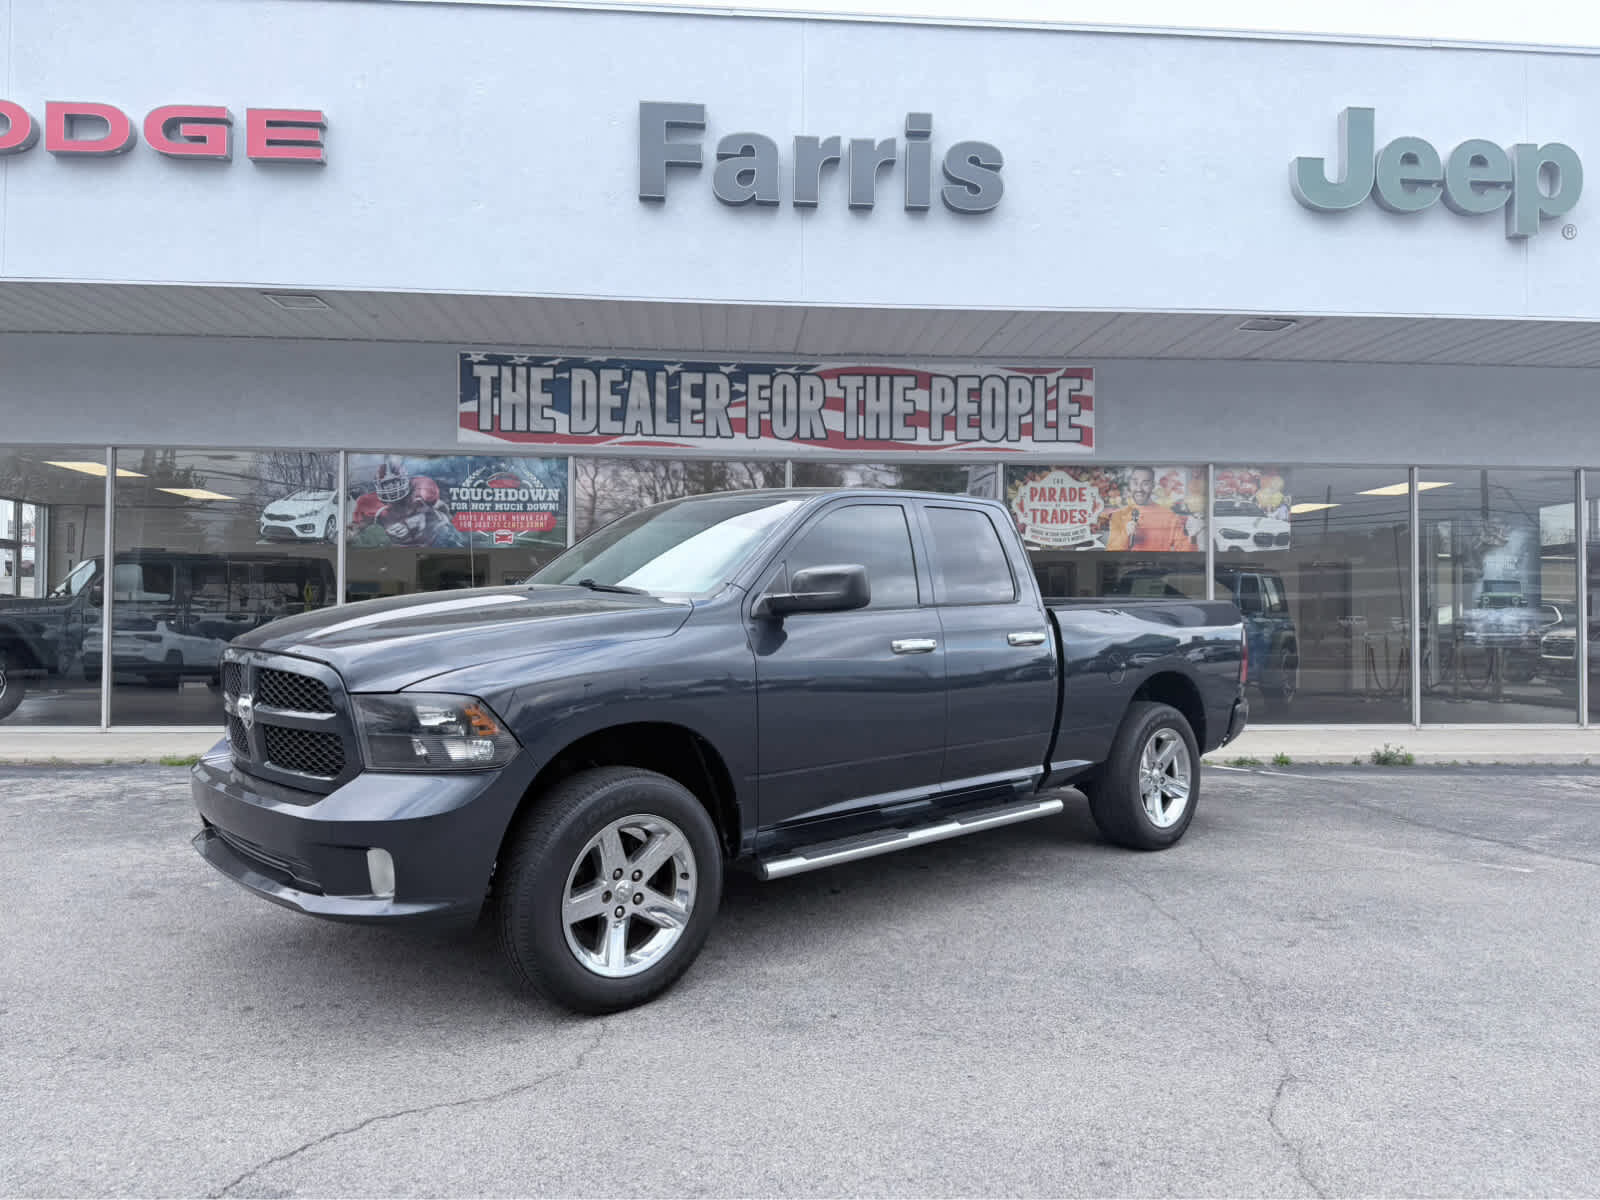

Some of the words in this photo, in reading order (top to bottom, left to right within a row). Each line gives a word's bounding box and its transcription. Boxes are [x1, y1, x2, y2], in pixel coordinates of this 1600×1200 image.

[638, 100, 1005, 214] Farris
[1288, 106, 1584, 239] Jeep
[472, 363, 557, 434] THE
[568, 367, 735, 439] DEALER
[745, 371, 828, 441] FOR
[837, 374, 919, 441] THE
[927, 374, 1084, 443] PEOPLE
[450, 488, 560, 501] TOUCHDOWN
[1030, 487, 1087, 502] PARADE
[451, 503, 468, 511] FOR
[471, 503, 491, 511] NOT
[495, 503, 524, 511] MUCH
[527, 503, 559, 511] DOWN!
[1029, 508, 1089, 524] TRADES
